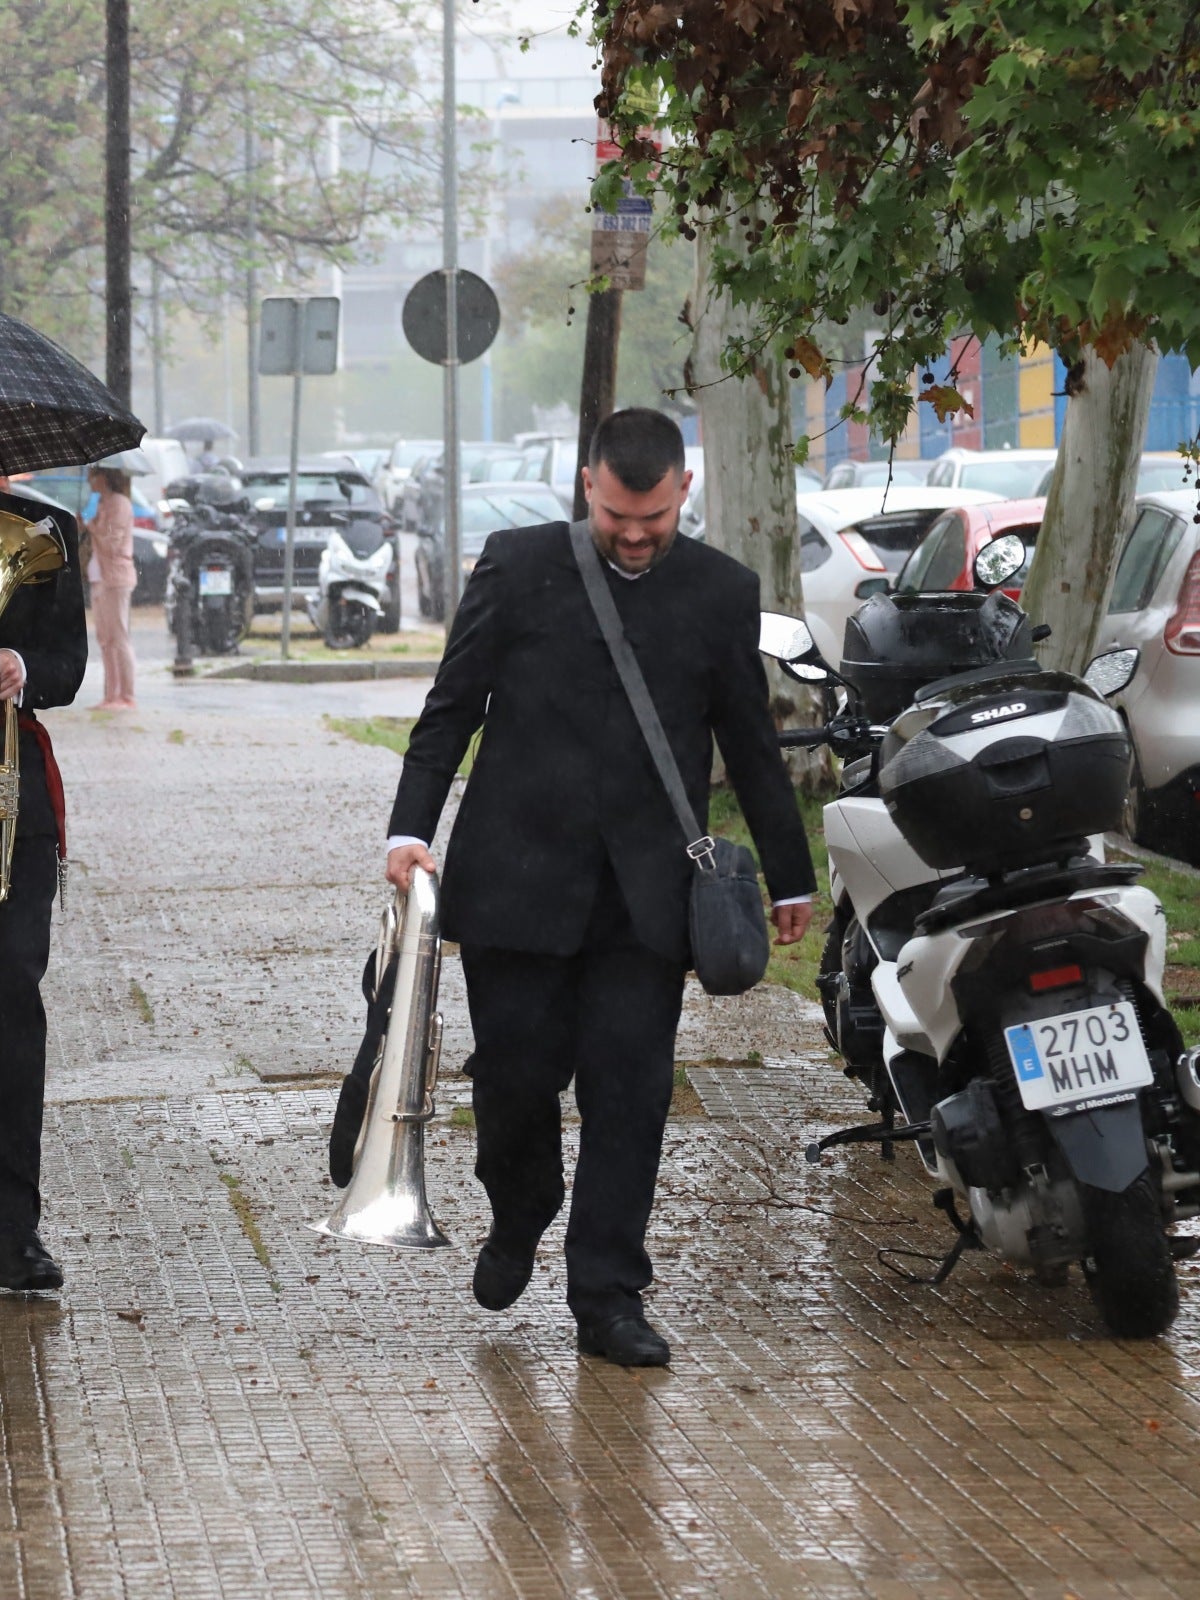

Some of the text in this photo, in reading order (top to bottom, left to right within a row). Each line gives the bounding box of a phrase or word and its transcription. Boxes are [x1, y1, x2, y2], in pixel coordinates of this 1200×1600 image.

[970, 702, 1027, 724] SHAD
[1040, 1011, 1130, 1058] 2703
[1023, 1058, 1035, 1071] E
[1048, 1049, 1119, 1093] MHM
[1075, 1092, 1137, 1111] el Motorista
